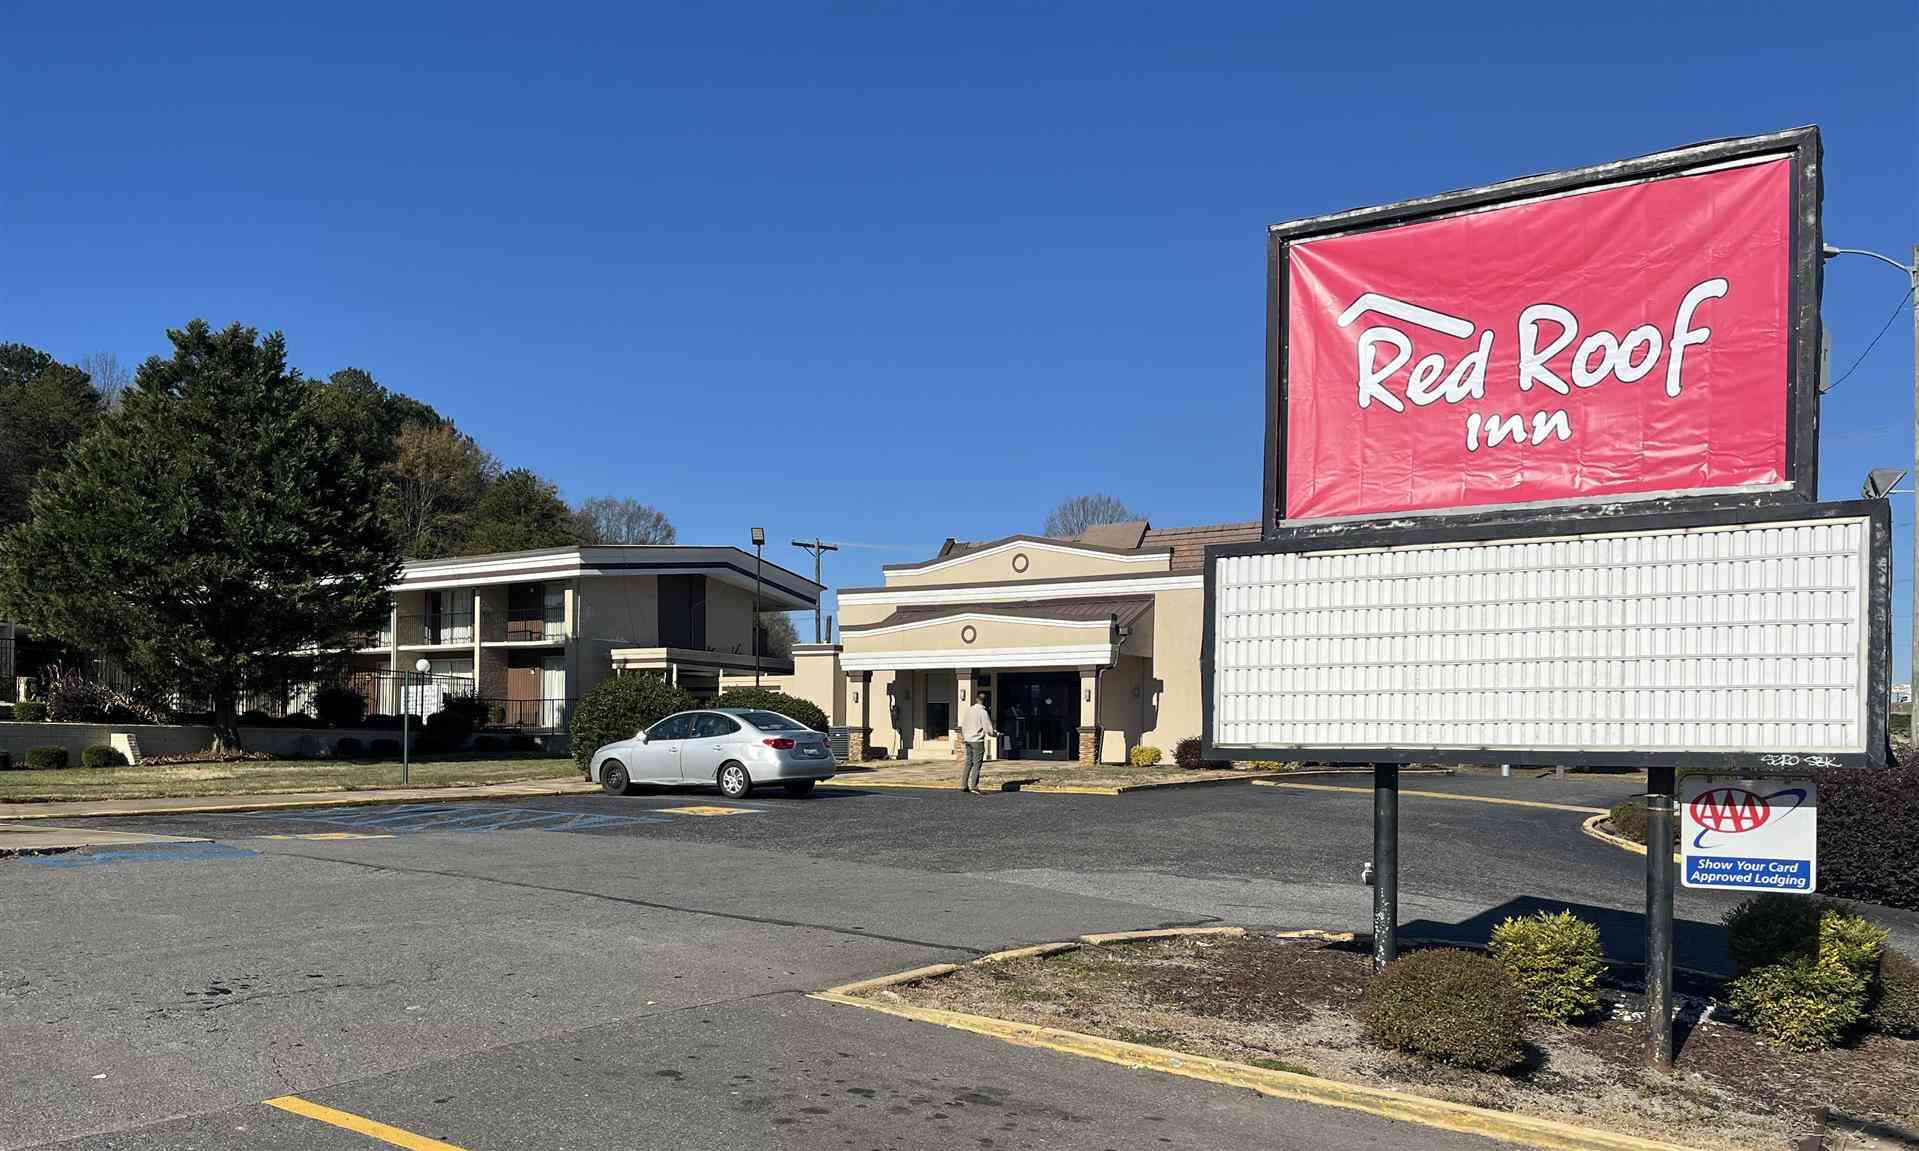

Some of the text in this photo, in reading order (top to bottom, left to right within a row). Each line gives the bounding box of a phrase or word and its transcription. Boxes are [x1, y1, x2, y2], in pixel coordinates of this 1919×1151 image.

[1357, 277, 1729, 412] Red Roof
[1465, 408, 1573, 452] inn
[1700, 790, 1761, 832] AAA
[1690, 871, 1807, 888] Approved Lodging
[1697, 859, 1799, 873] Show Your Card
